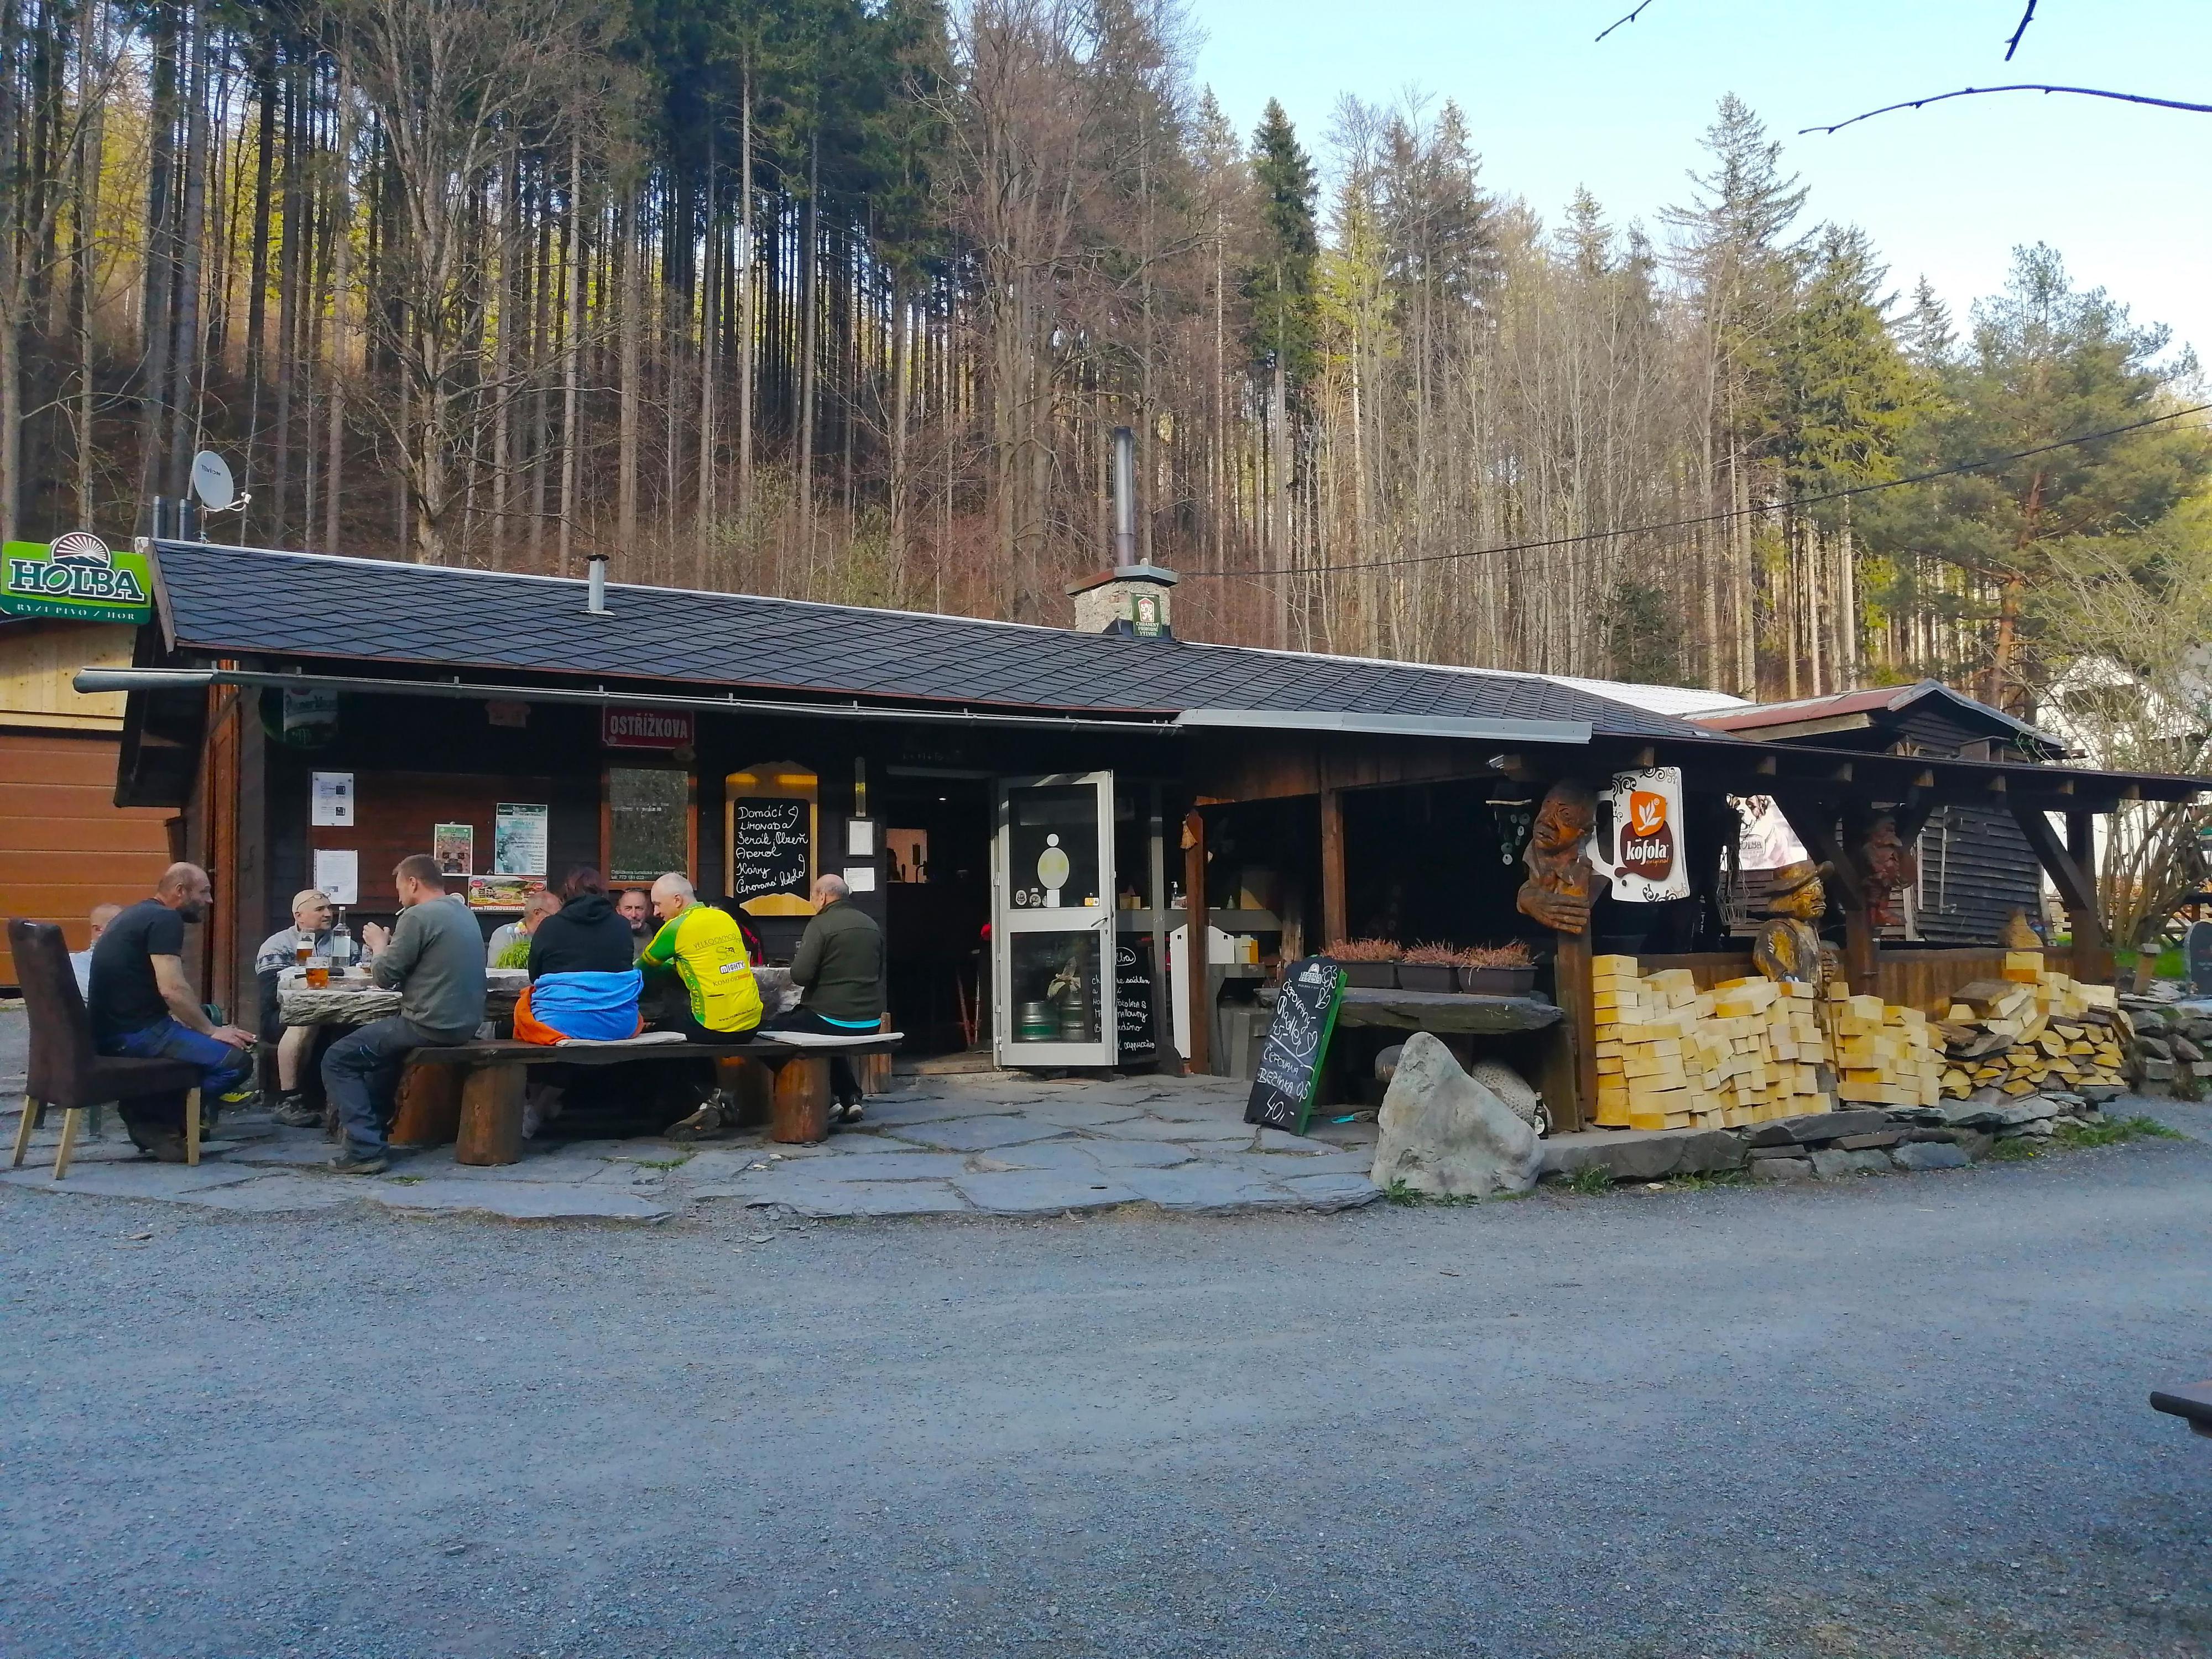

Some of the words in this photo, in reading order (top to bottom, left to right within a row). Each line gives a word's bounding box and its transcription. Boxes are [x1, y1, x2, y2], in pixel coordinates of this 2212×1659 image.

[8, 559, 145, 602] HOLBA
[610, 713, 688, 739] OSTŘÍŽKOVA
[737, 804, 784, 820] Domácí
[775, 831, 808, 845] Plzeň
[1741, 841, 1763, 850] OLBA
[735, 846, 782, 860] Aperol
[1646, 855, 1670, 867] original
[736, 862, 771, 879] Kávy
[736, 876, 776, 894] Čepovaná
[1298, 972, 1322, 984] HOLBA
